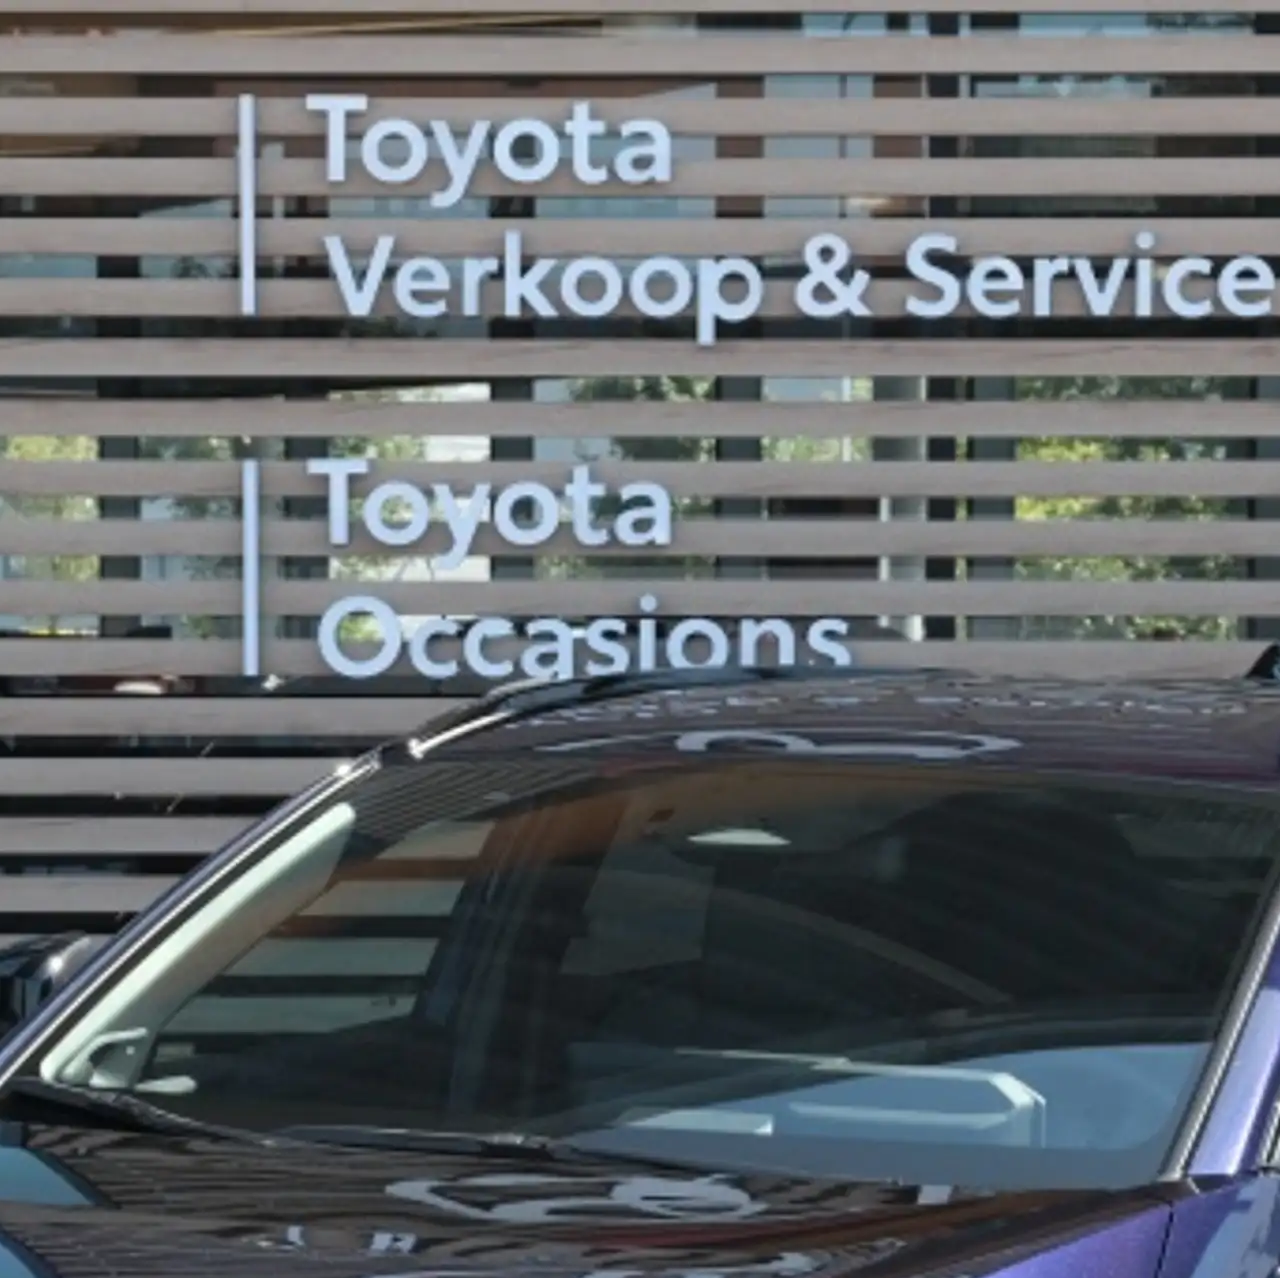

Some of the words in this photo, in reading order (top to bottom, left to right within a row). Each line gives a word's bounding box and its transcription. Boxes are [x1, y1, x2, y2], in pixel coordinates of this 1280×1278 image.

[306, 93, 674, 208] Toyota
[323, 230, 764, 346] Verkoop
[793, 233, 872, 318] &
[904, 231, 1278, 319] Service
[306, 458, 674, 570] Toyota
[318, 593, 852, 681] Occasions
